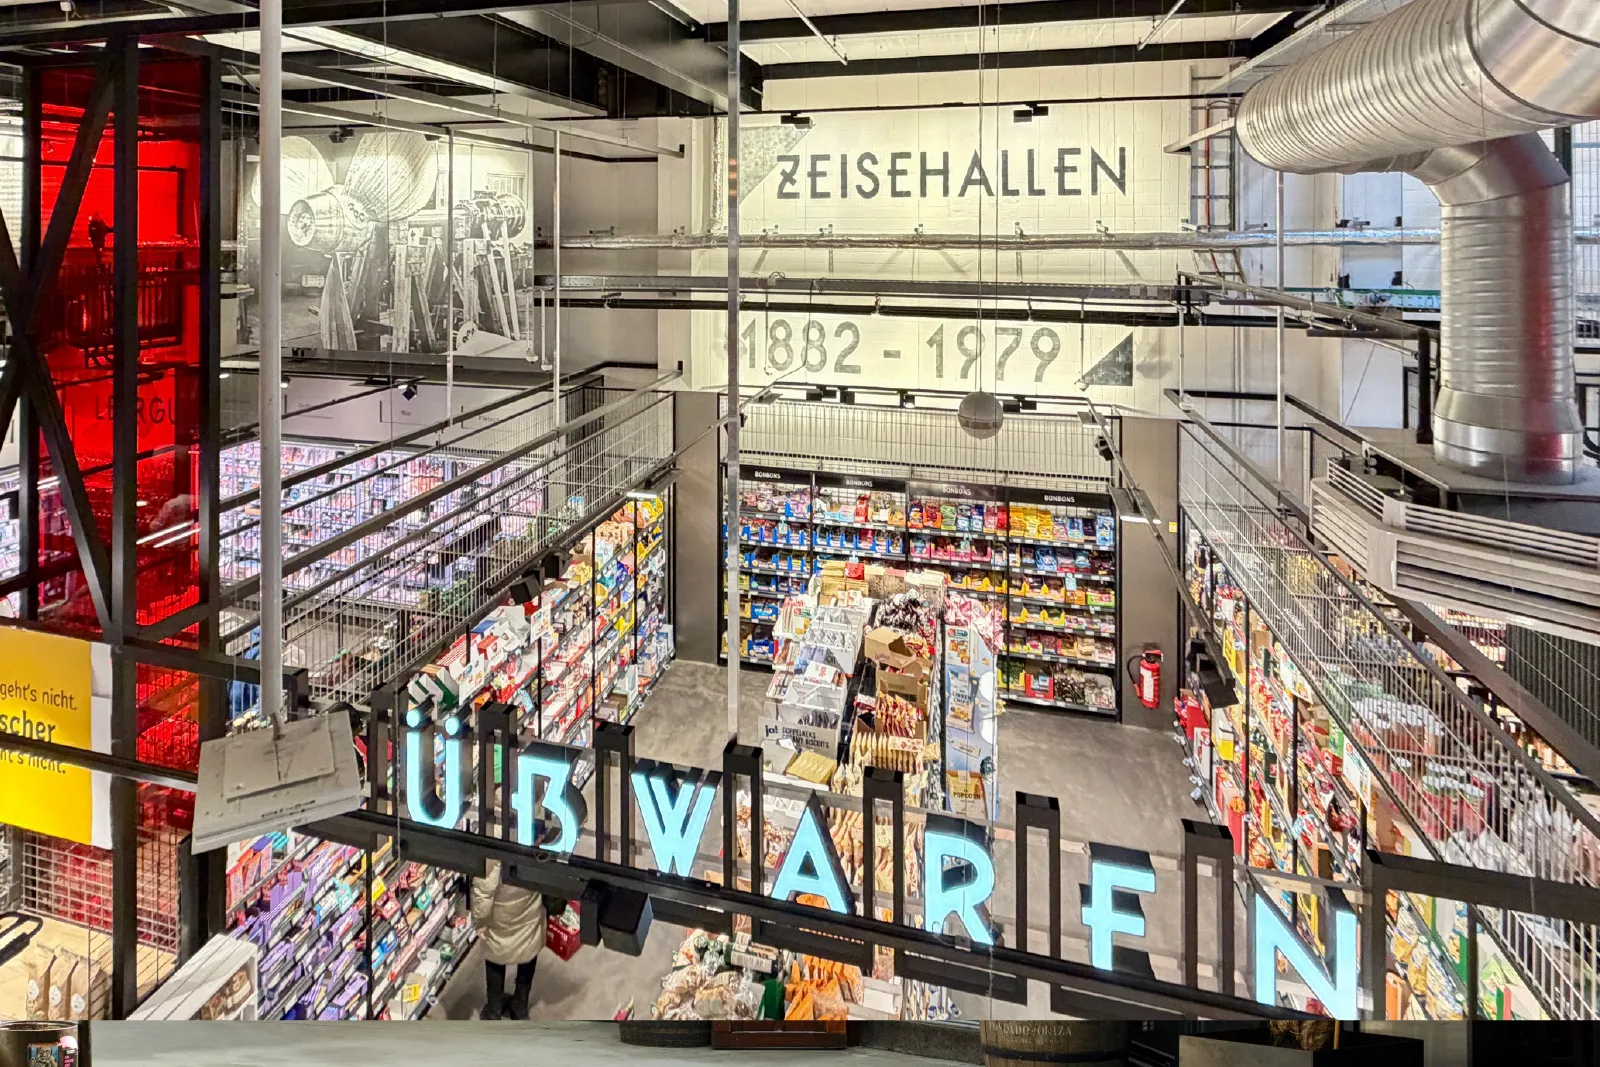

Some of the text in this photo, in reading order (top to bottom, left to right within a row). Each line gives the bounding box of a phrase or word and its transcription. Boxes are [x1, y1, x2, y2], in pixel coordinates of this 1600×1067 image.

[776, 147, 1127, 199] ZEISEHALLEN
[741, 317, 862, 374] 1882
[926, 324, 1061, 382] 1979
[755, 471, 781, 480] BONBONS
[846, 479, 873, 488] BONBONS
[1044, 494, 1075, 503] BONBONS
[42, 688, 78, 711] nicht.
